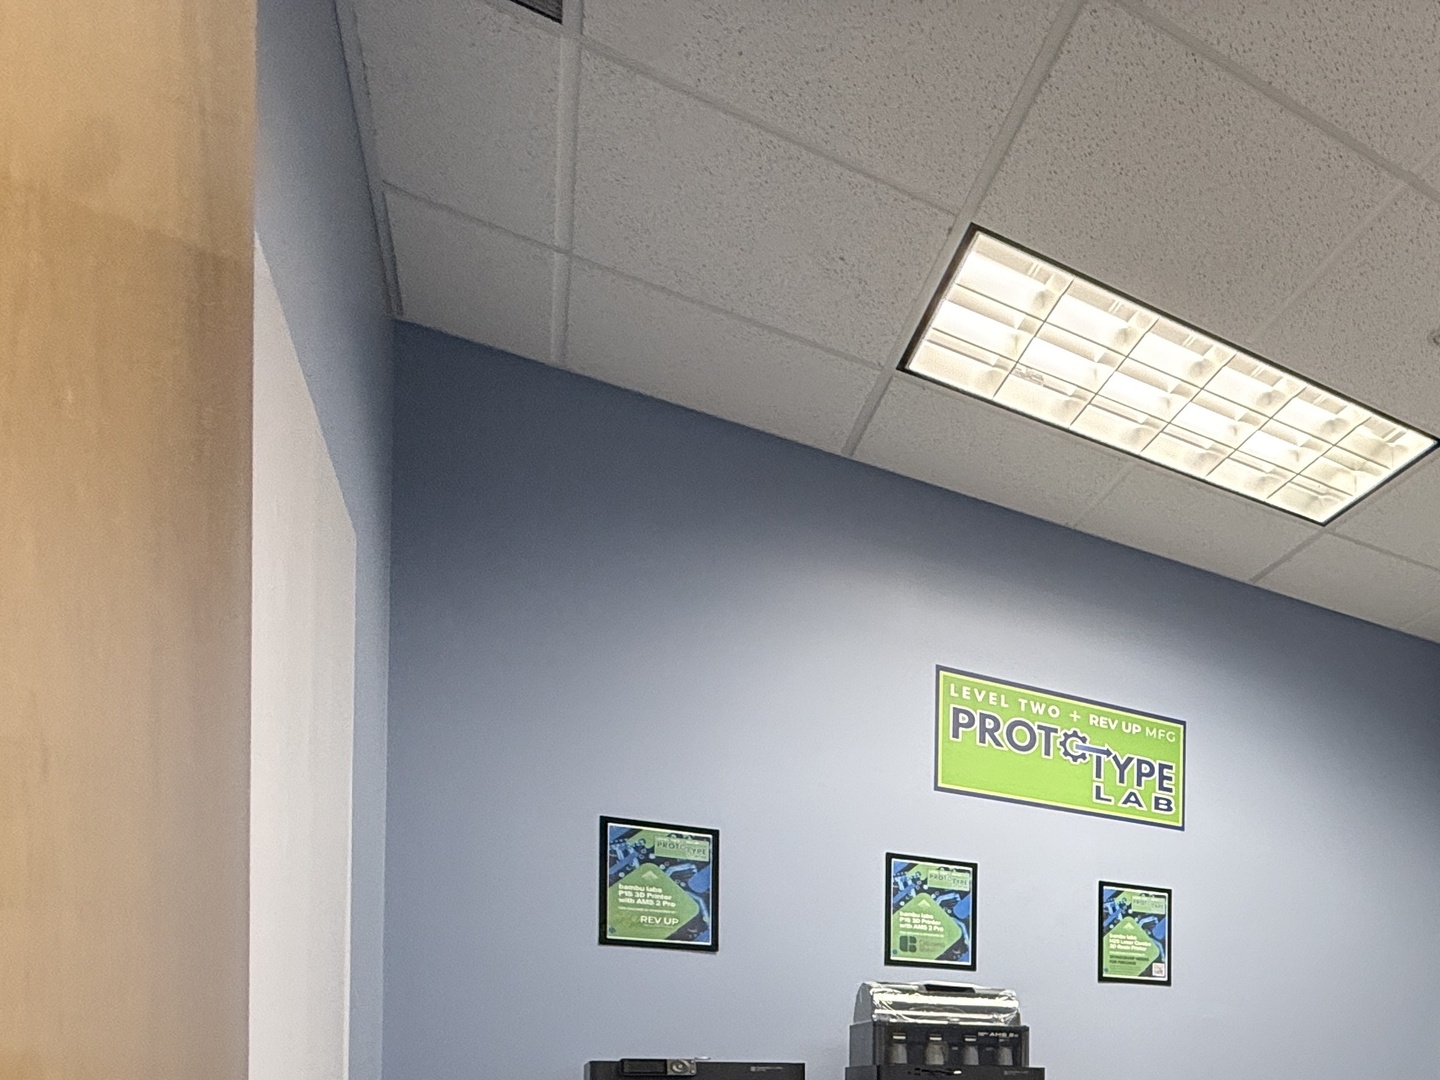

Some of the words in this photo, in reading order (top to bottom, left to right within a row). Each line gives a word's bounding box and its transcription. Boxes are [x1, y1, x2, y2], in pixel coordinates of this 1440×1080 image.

[950, 683, 1009, 708] LEVEL
[1018, 698, 1060, 718] TWO
[1089, 713, 1118, 730] REV
[1121, 721, 1142, 735] UP
[1145, 728, 1176, 743] MFG
[1094, 785, 1174, 813] LAB
[640, 915, 662, 924] REV
[663, 917, 679, 926] UP
